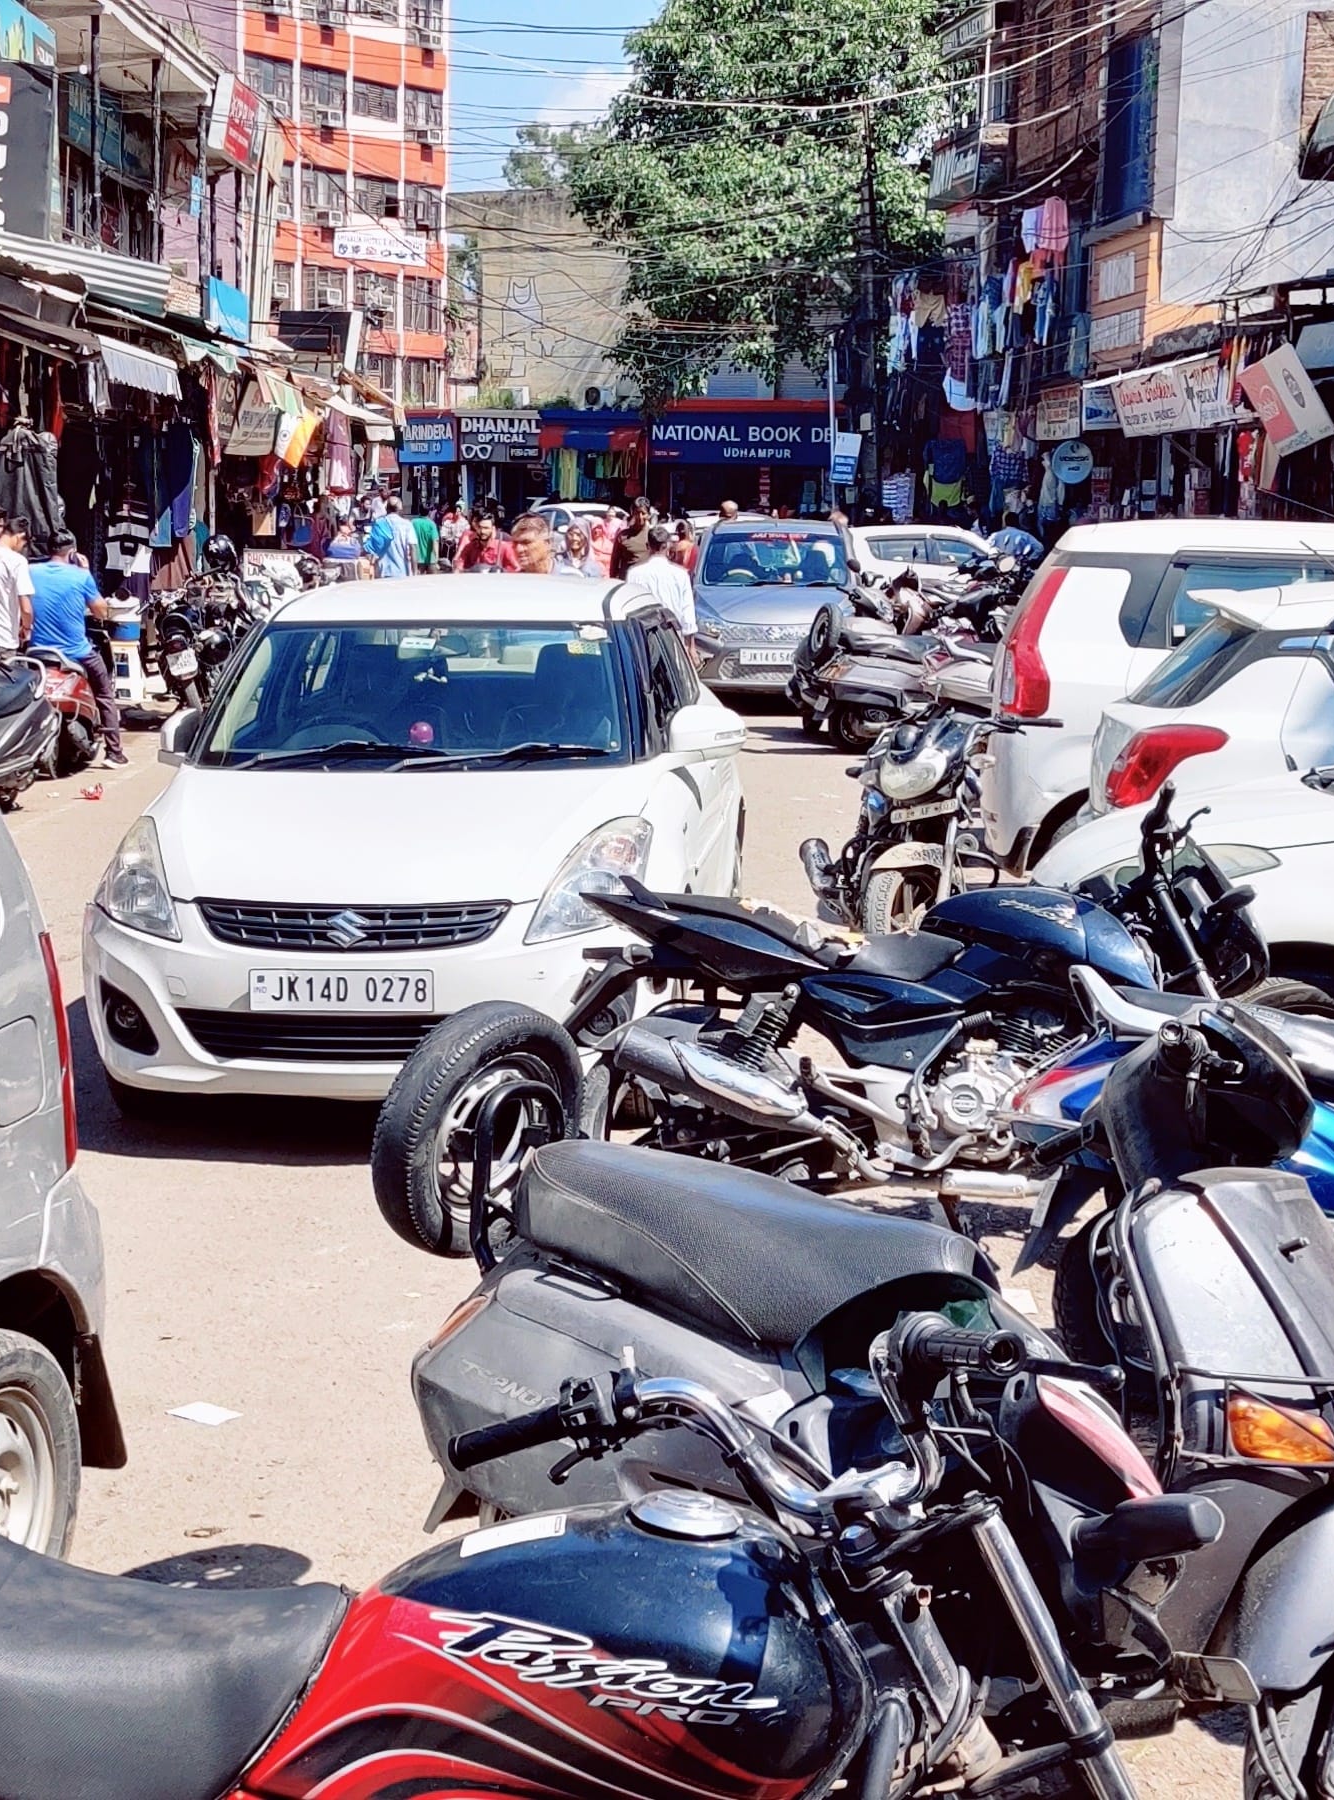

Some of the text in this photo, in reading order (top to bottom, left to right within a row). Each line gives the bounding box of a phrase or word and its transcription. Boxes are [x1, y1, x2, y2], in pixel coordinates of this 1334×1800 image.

[403, 422, 453, 441] ARINDERA
[460, 417, 542, 434] DHANJAL
[651, 424, 741, 442] NATIONAL
[748, 426, 803, 443] BOOK
[478, 433, 526, 443] OPTICAL
[723, 447, 792, 459] UDHAMPUR
[269, 976, 428, 1004] JK14D 0278
[429, 1610, 779, 1709] Passion
[588, 1692, 741, 1726] PRO
